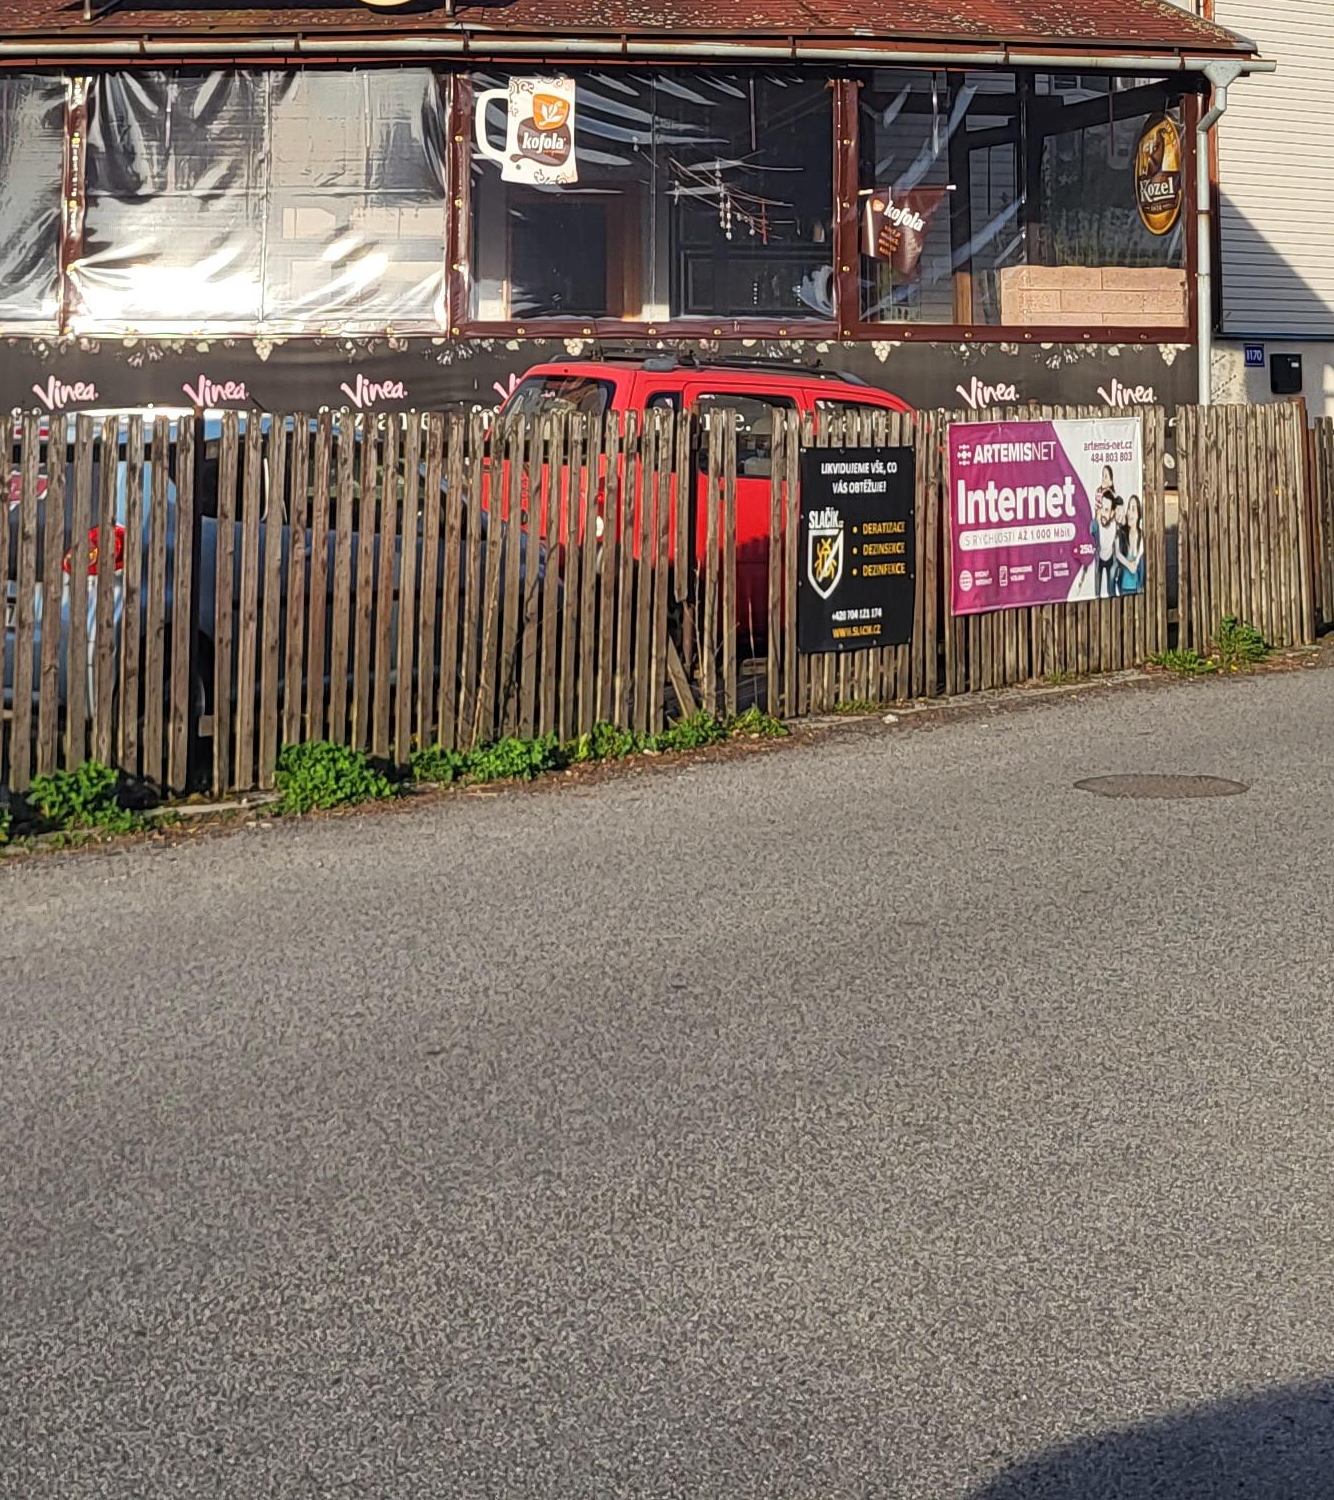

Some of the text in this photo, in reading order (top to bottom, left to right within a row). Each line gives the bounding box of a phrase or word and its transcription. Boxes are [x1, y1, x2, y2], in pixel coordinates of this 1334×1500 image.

[522, 132, 565, 154] kofola
[1139, 176, 1175, 203] Kozel
[883, 200, 925, 232] kofola
[1246, 349, 1263, 362] 1170
[973, 441, 1056, 465] ARTEMISNET
[1083, 438, 1133, 451] artemis-net.cz
[821, 459, 898, 476] LIKVIDUJEME VŠE, CO
[832, 478, 886, 495] VÁS OBTĚŽUJE!
[957, 476, 1076, 525] Internet
[862, 521, 906, 536] DERATIZACE
[862, 542, 906, 556] DEZINSEKCE
[862, 563, 906, 577] DEZINFEKCE
